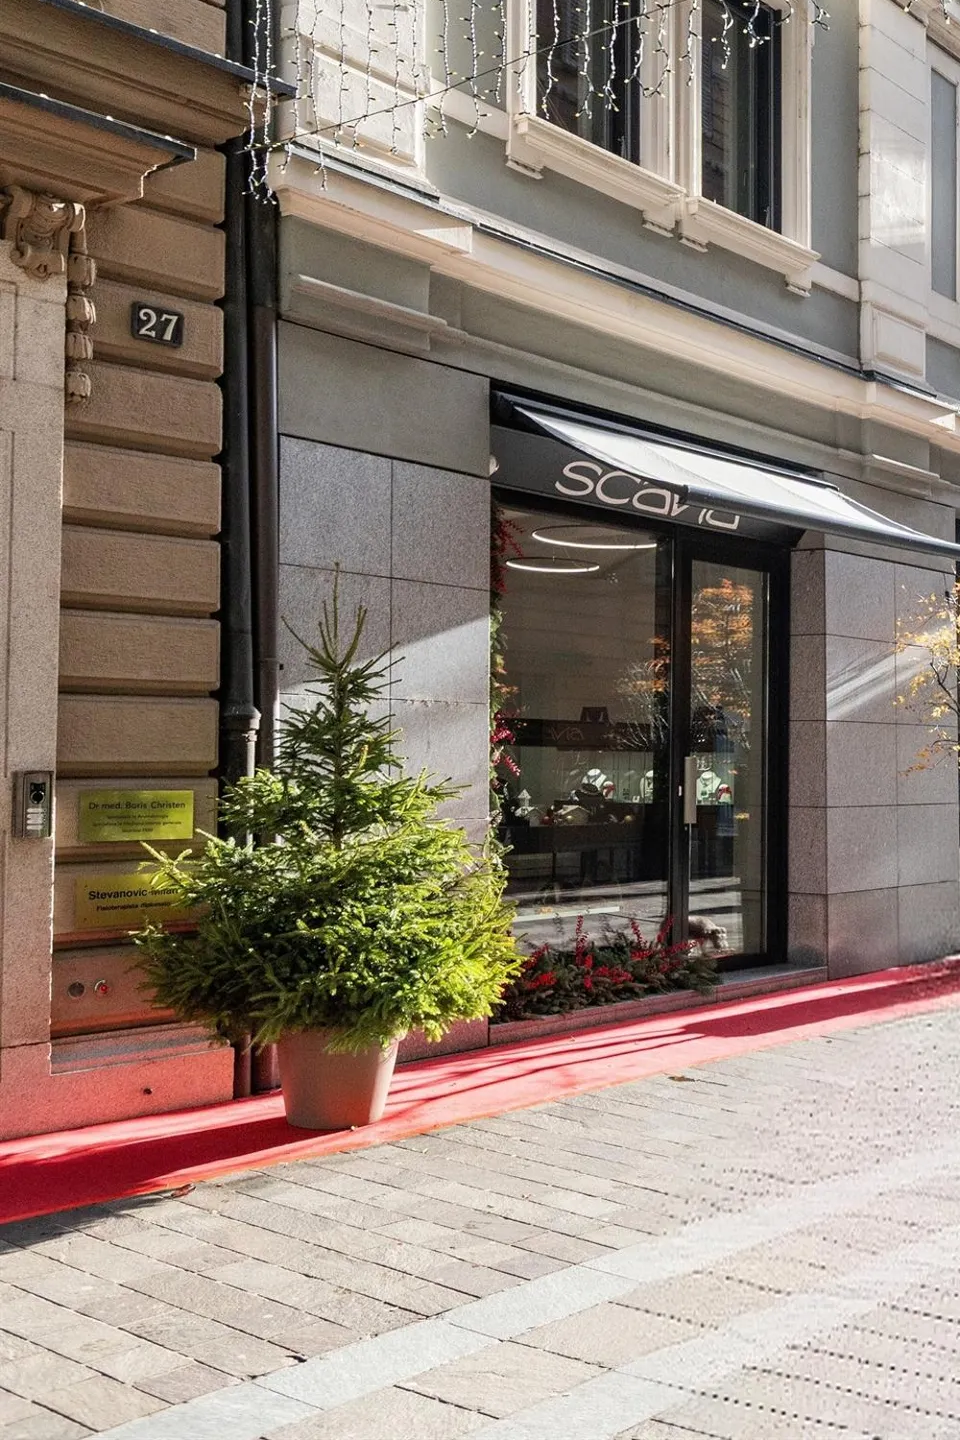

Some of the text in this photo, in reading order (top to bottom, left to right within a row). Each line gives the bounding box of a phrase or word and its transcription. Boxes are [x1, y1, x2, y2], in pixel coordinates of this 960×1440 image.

[139, 308, 179, 340] 27
[125, 801, 148, 809] Boris
[150, 801, 186, 809] Christen
